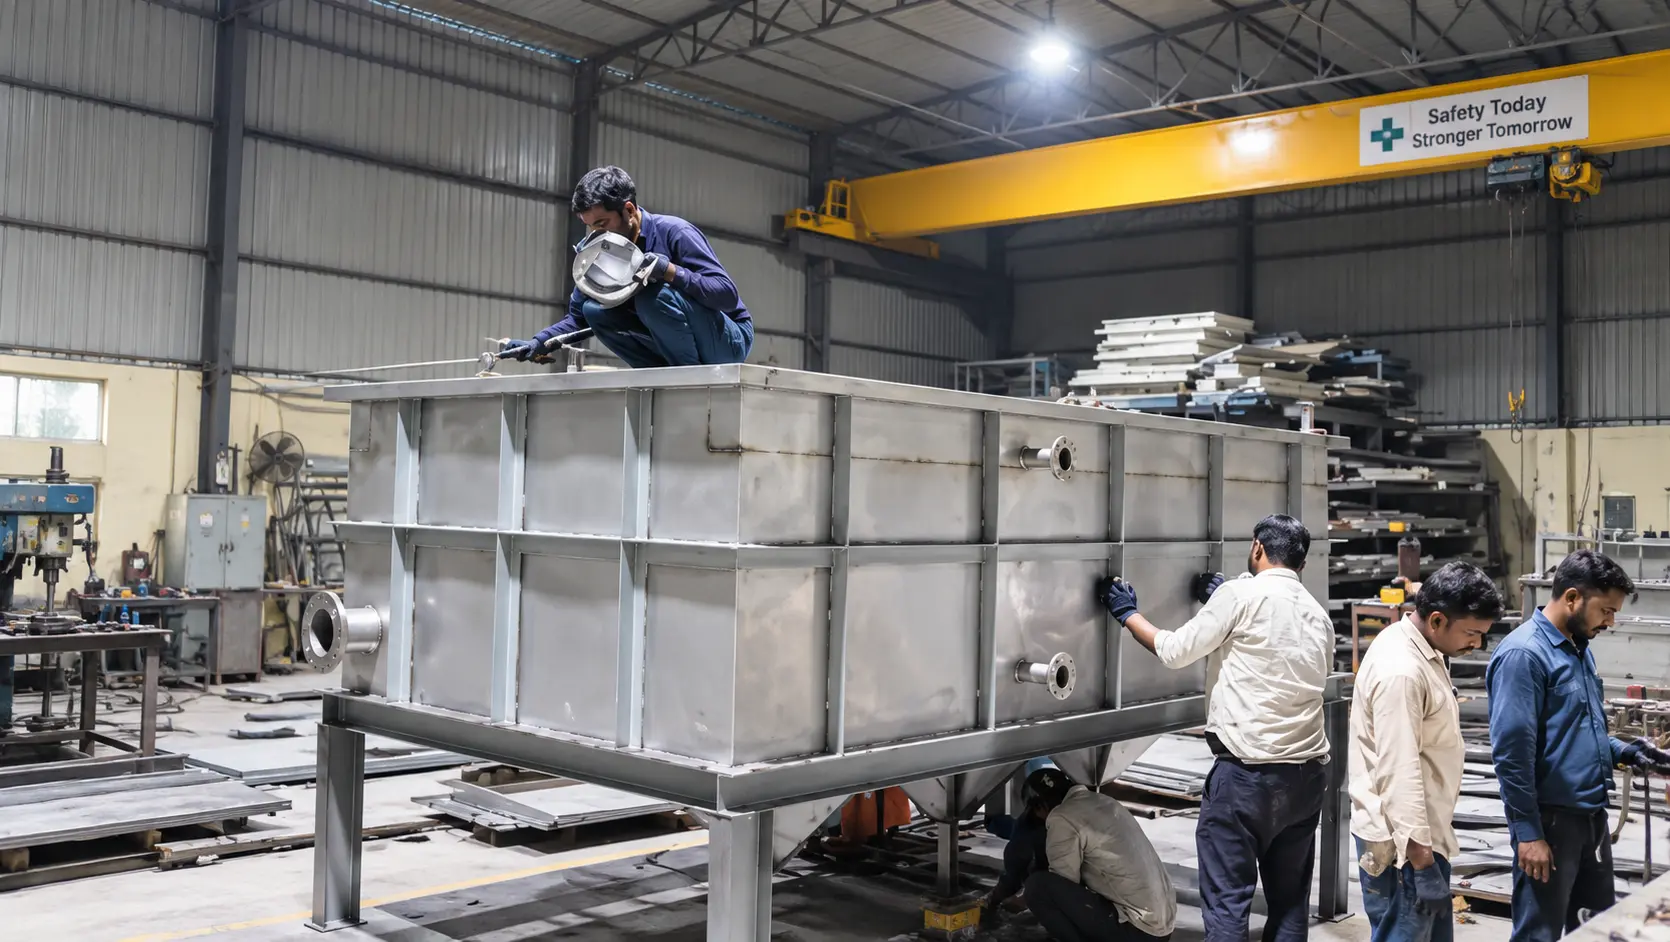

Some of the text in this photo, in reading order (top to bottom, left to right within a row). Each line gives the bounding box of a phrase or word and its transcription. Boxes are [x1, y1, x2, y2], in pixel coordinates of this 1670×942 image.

[1428, 96, 1547, 125] Safety Today
[1412, 117, 1573, 149] Stronger Tomorrow
